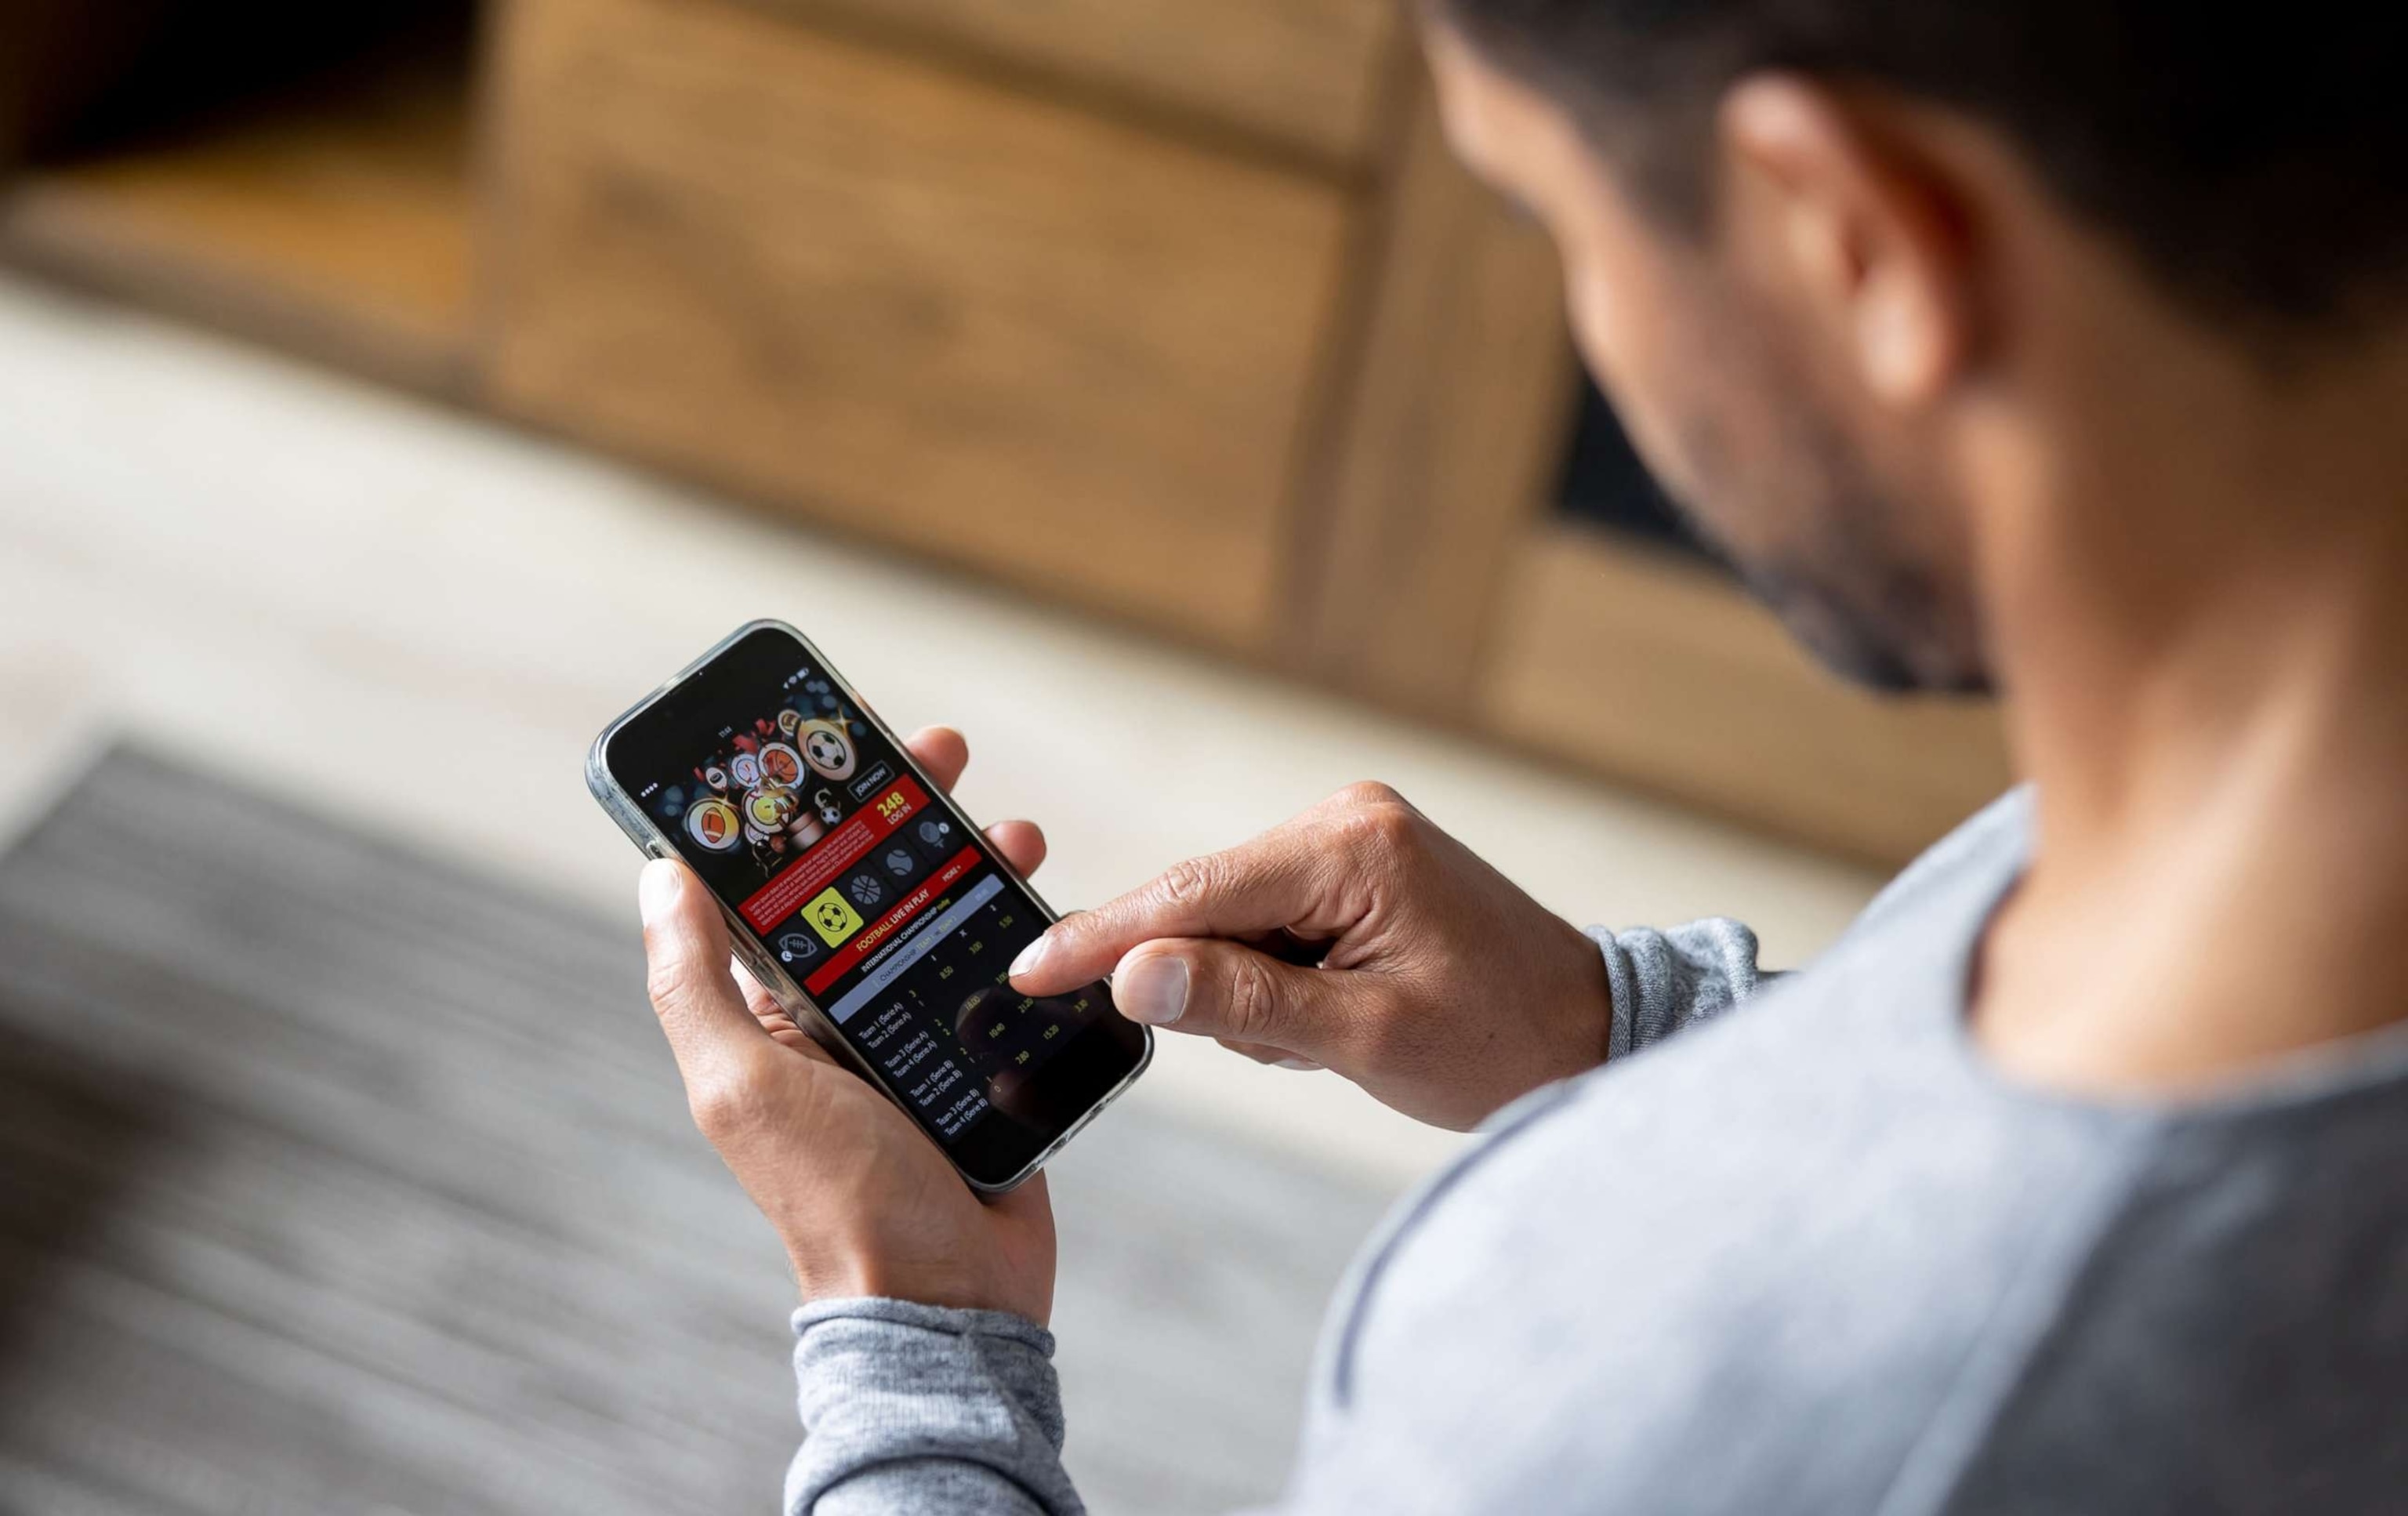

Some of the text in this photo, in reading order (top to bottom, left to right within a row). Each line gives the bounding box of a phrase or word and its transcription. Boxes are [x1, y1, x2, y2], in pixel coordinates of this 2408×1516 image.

[855, 767, 885, 796] JOIN NOW
[877, 792, 904, 816] 248
[887, 803, 912, 825] LOG IN
[942, 867, 958, 881] MORE
[856, 889, 929, 951] FOOTBALL LIVE IN PLAY
[861, 938, 902, 971] INTERNATIONAL
[901, 907, 937, 939] CHAMPIONSHIP
[879, 948, 916, 981] CHAMPIONSHIP
[858, 1025, 876, 1039] Team
[879, 1009, 895, 1025] (Serie
[894, 1003, 903, 1011] A)
[867, 1035, 884, 1048] Team
[887, 1018, 904, 1034] (Serie
[901, 1012, 912, 1021] A)
[884, 1054, 901, 1068] Team
[904, 1038, 921, 1054] (Serie
[919, 1031, 928, 1040] A)
[893, 1064, 910, 1078] Team
[912, 1047, 930, 1063] (Serie
[927, 1040, 937, 1050] A)
[910, 1083, 927, 1097] Team
[930, 1066, 947, 1083] (Serie
[943, 1060, 954, 1068] B)
[919, 1093, 935, 1106] Team
[938, 1075, 956, 1092] (Serie
[952, 1069, 963, 1079] B)
[936, 1112, 952, 1125] Team
[956, 1095, 972, 1111] (Serie
[969, 1089, 979, 1097] B)
[945, 1122, 962, 1135] Team
[964, 1104, 981, 1120] (Serie
[977, 1098, 988, 1107] B)
